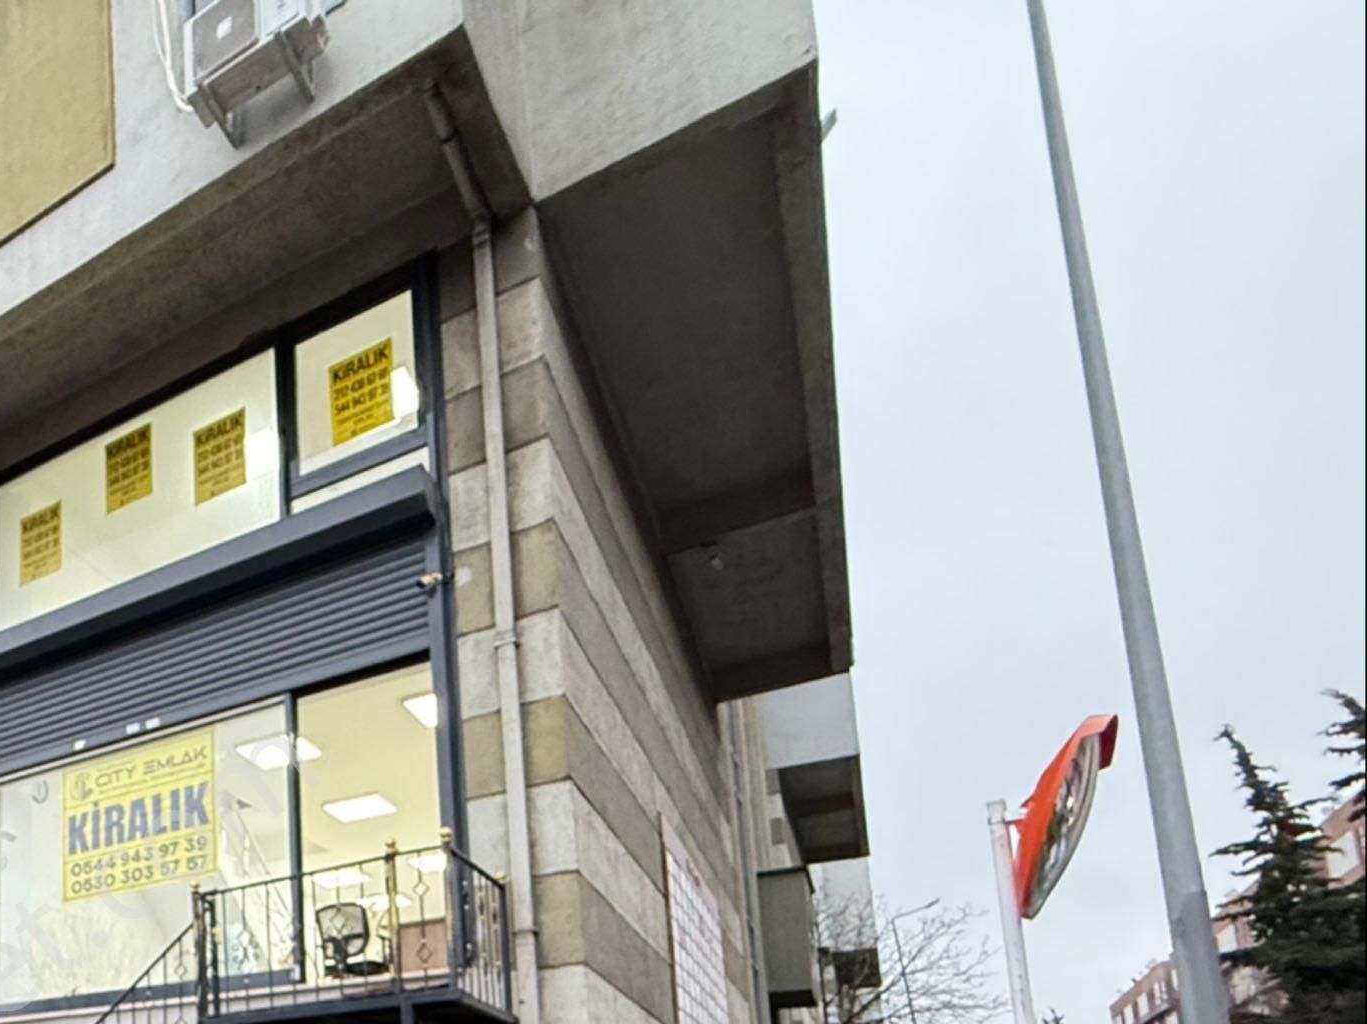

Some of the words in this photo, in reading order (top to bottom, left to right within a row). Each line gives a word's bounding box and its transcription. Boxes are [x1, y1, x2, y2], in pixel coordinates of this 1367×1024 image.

[142, 745, 207, 775] EMLAK
[68, 781, 210, 855] KİRALIK
[71, 857, 116, 877] 0544
[121, 846, 153, 866] 943
[159, 840, 179, 858] 97
[184, 835, 208, 853] 39
[71, 873, 116, 895] 0530
[121, 865, 154, 885] 303
